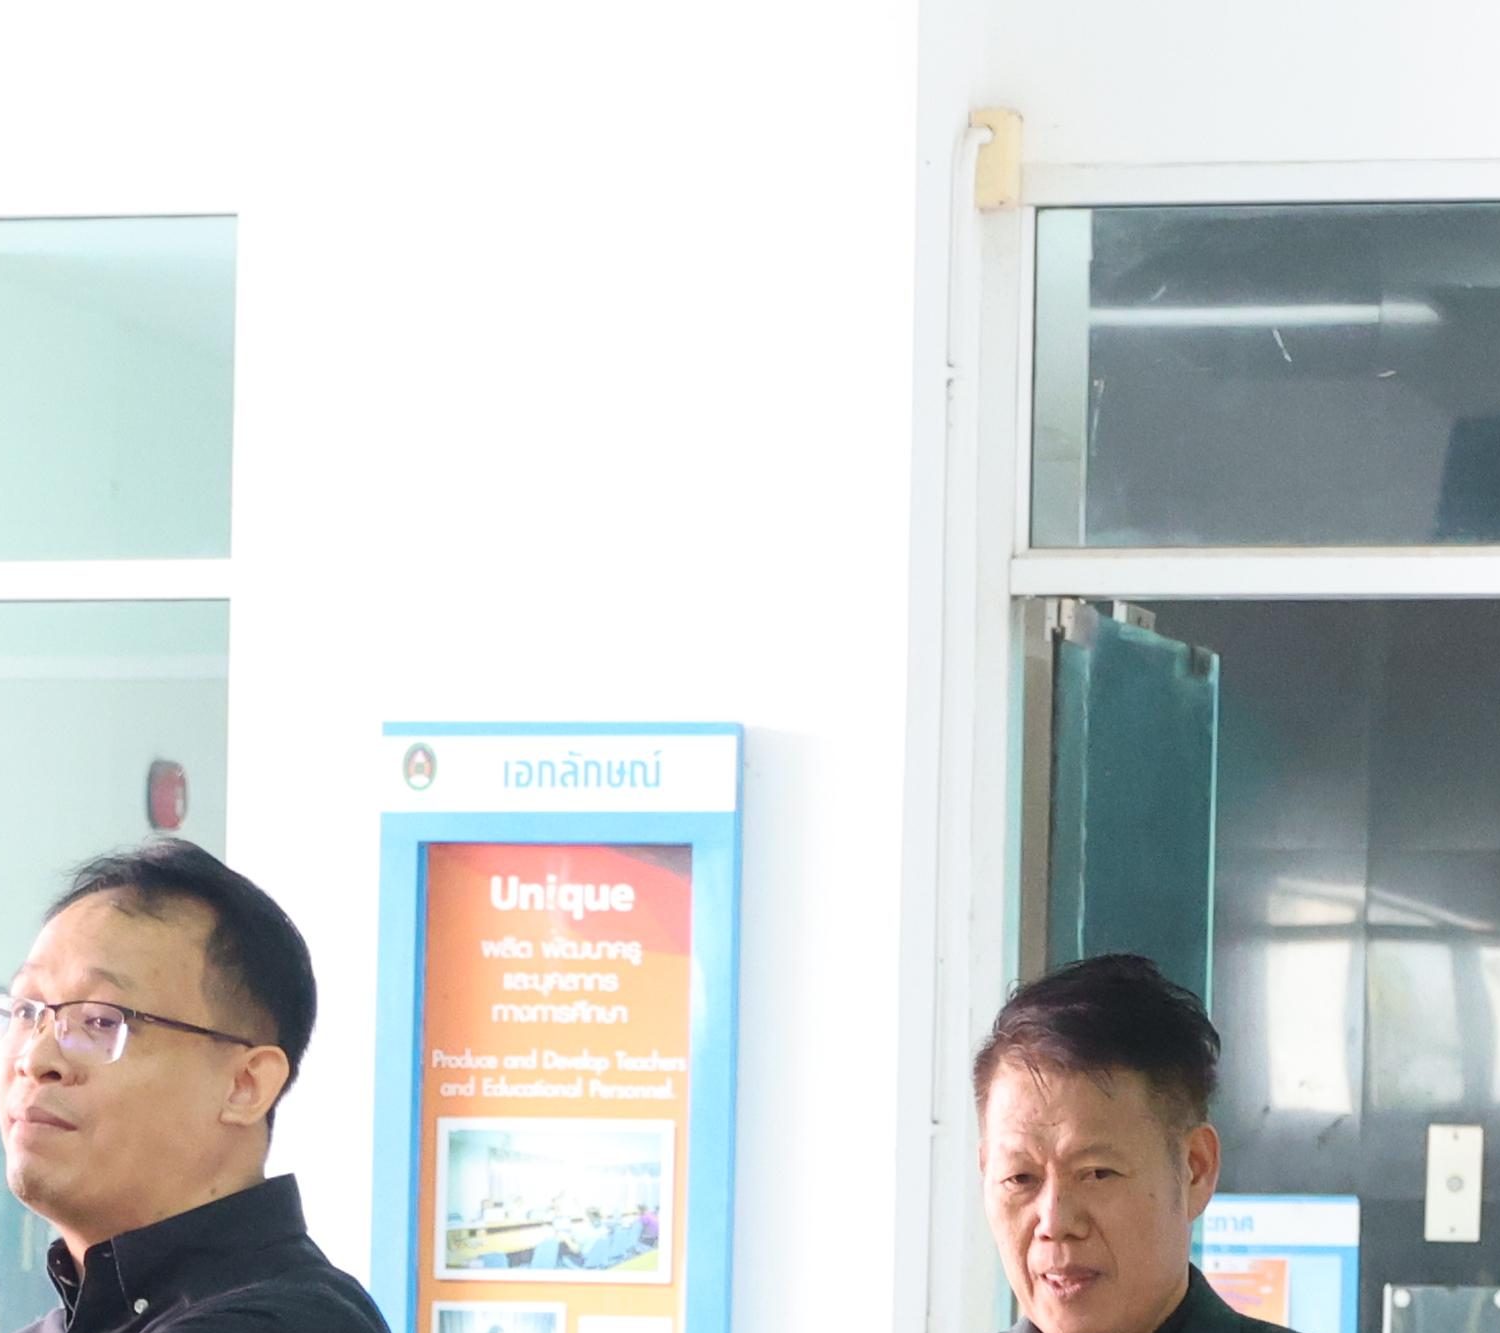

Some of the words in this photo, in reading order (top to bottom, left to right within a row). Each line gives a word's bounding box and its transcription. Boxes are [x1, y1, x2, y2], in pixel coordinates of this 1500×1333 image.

[503, 750, 663, 788] เอกลักษณ์
[490, 875, 636, 920] Unique
[432, 1049, 497, 1071] Produce
[503, 1050, 537, 1071] and
[542, 1050, 609, 1077] Develop
[615, 1051, 686, 1072] Teachers
[440, 1076, 475, 1097] and
[482, 1077, 584, 1098] Educational
